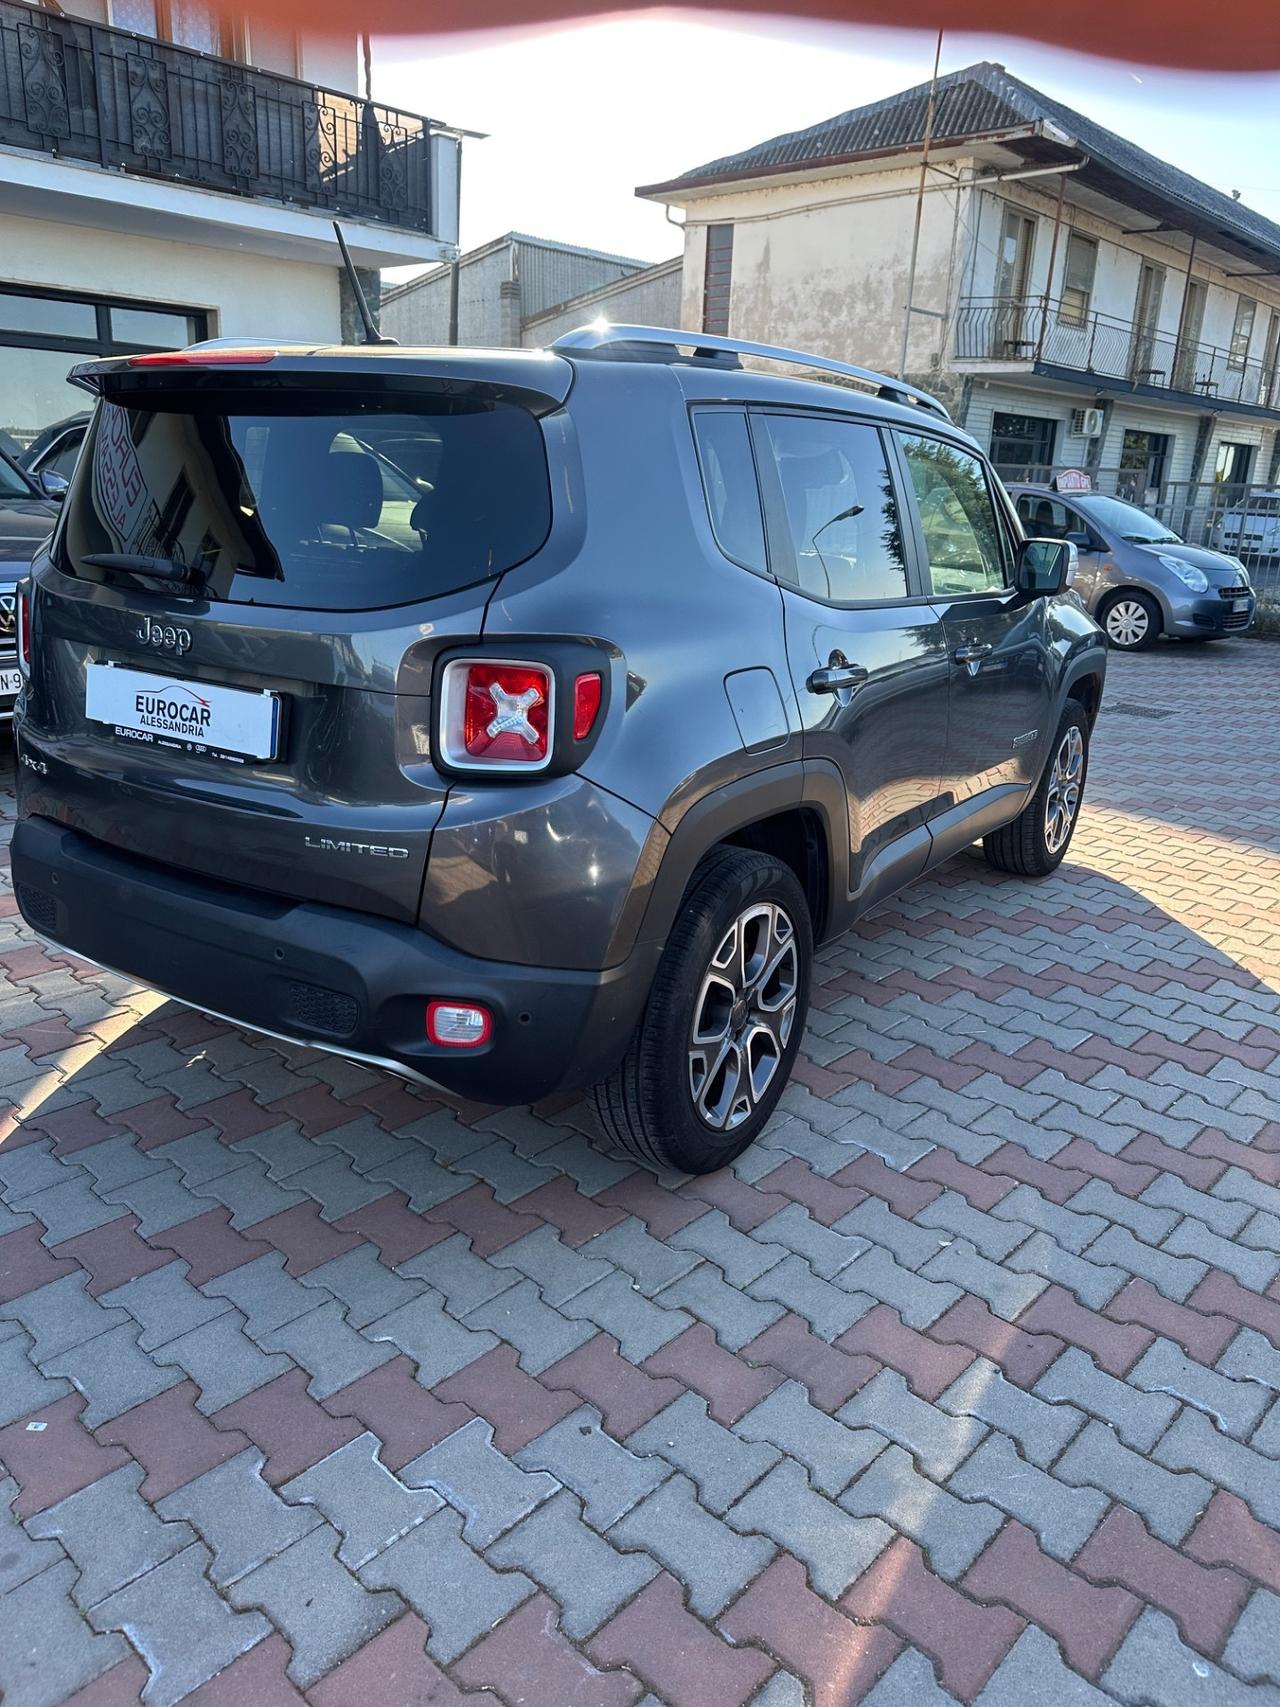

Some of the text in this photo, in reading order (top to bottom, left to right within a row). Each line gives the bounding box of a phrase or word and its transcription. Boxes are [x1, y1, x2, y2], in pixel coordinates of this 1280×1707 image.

[136, 617, 191, 656] Jeep
[136, 696, 211, 727] EUROCAR
[115, 726, 154, 743] EUROCAR
[140, 715, 205, 738] ALESSANDRIA
[305, 836, 409, 859] LIMITED
